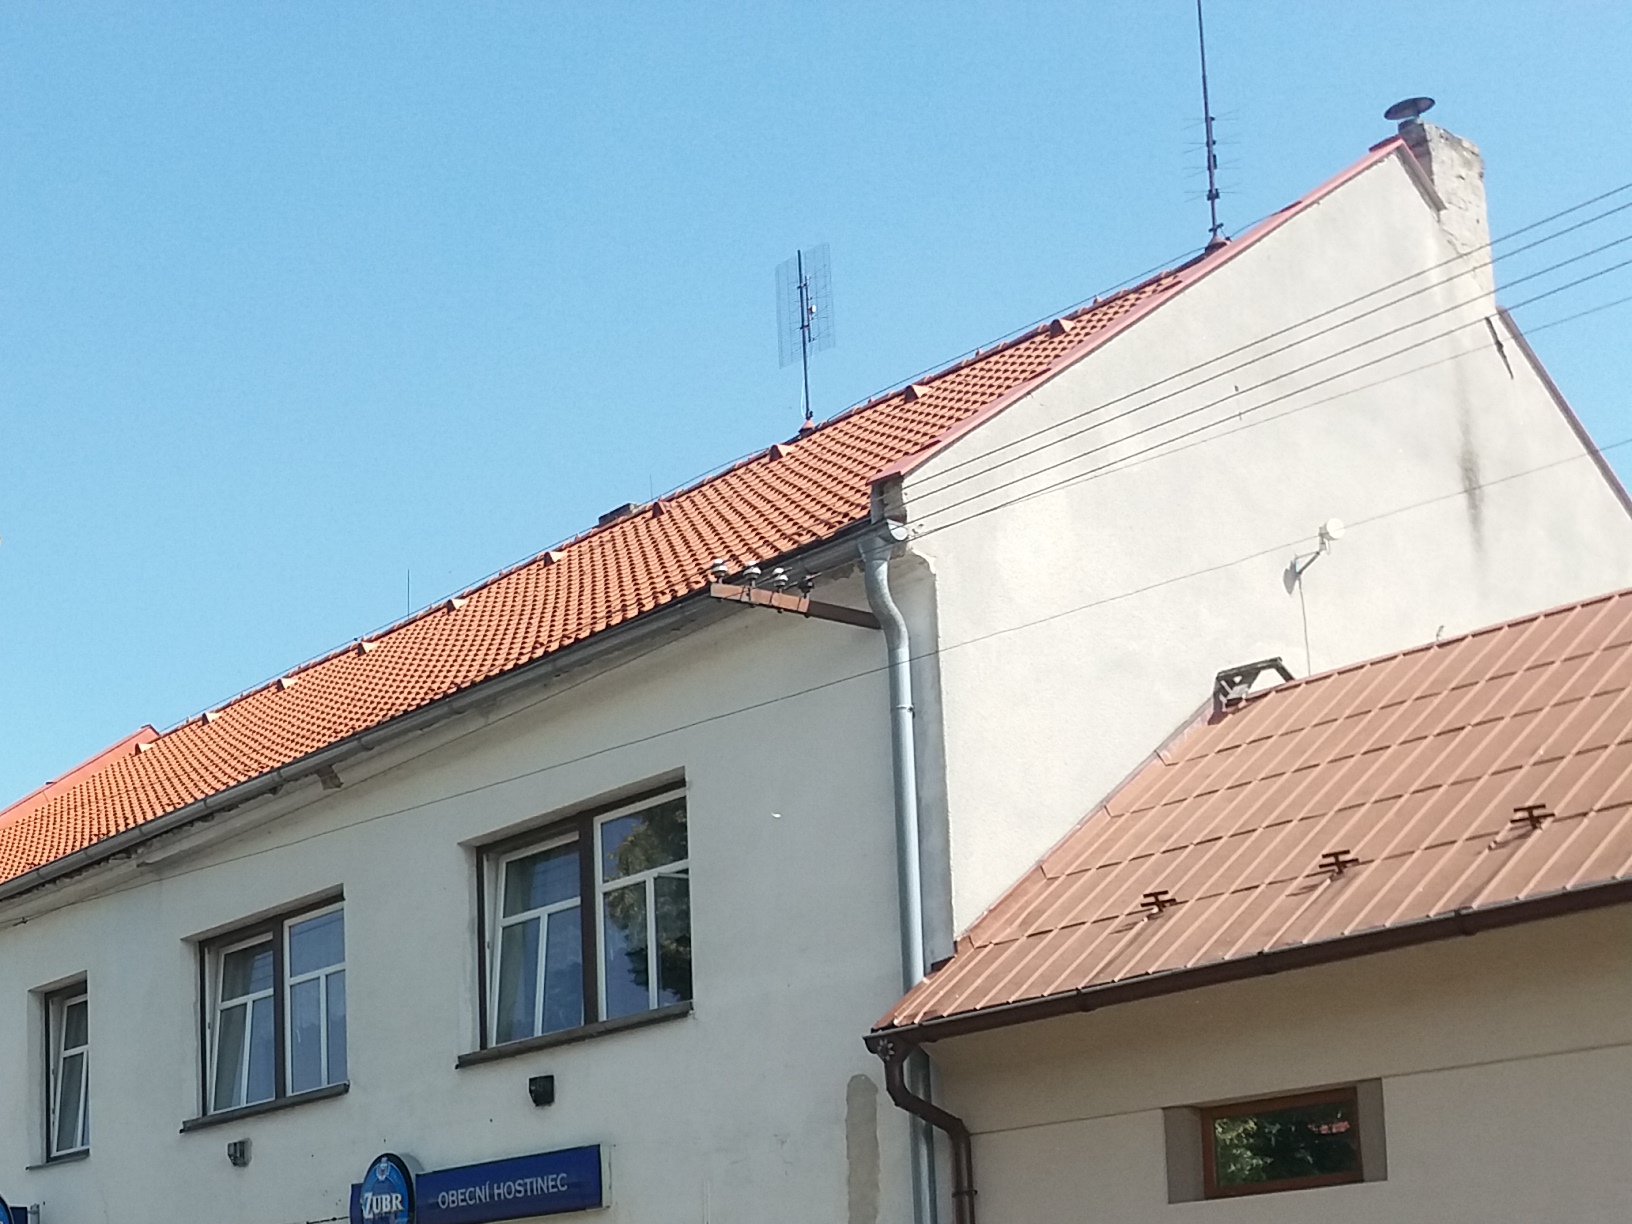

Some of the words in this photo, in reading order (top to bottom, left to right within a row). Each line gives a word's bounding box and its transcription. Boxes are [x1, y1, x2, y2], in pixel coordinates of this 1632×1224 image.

[362, 1192, 405, 1219] ZUBR
[438, 1181, 490, 1209] OBECNÍ
[494, 1173, 568, 1200] HOSTINEC
